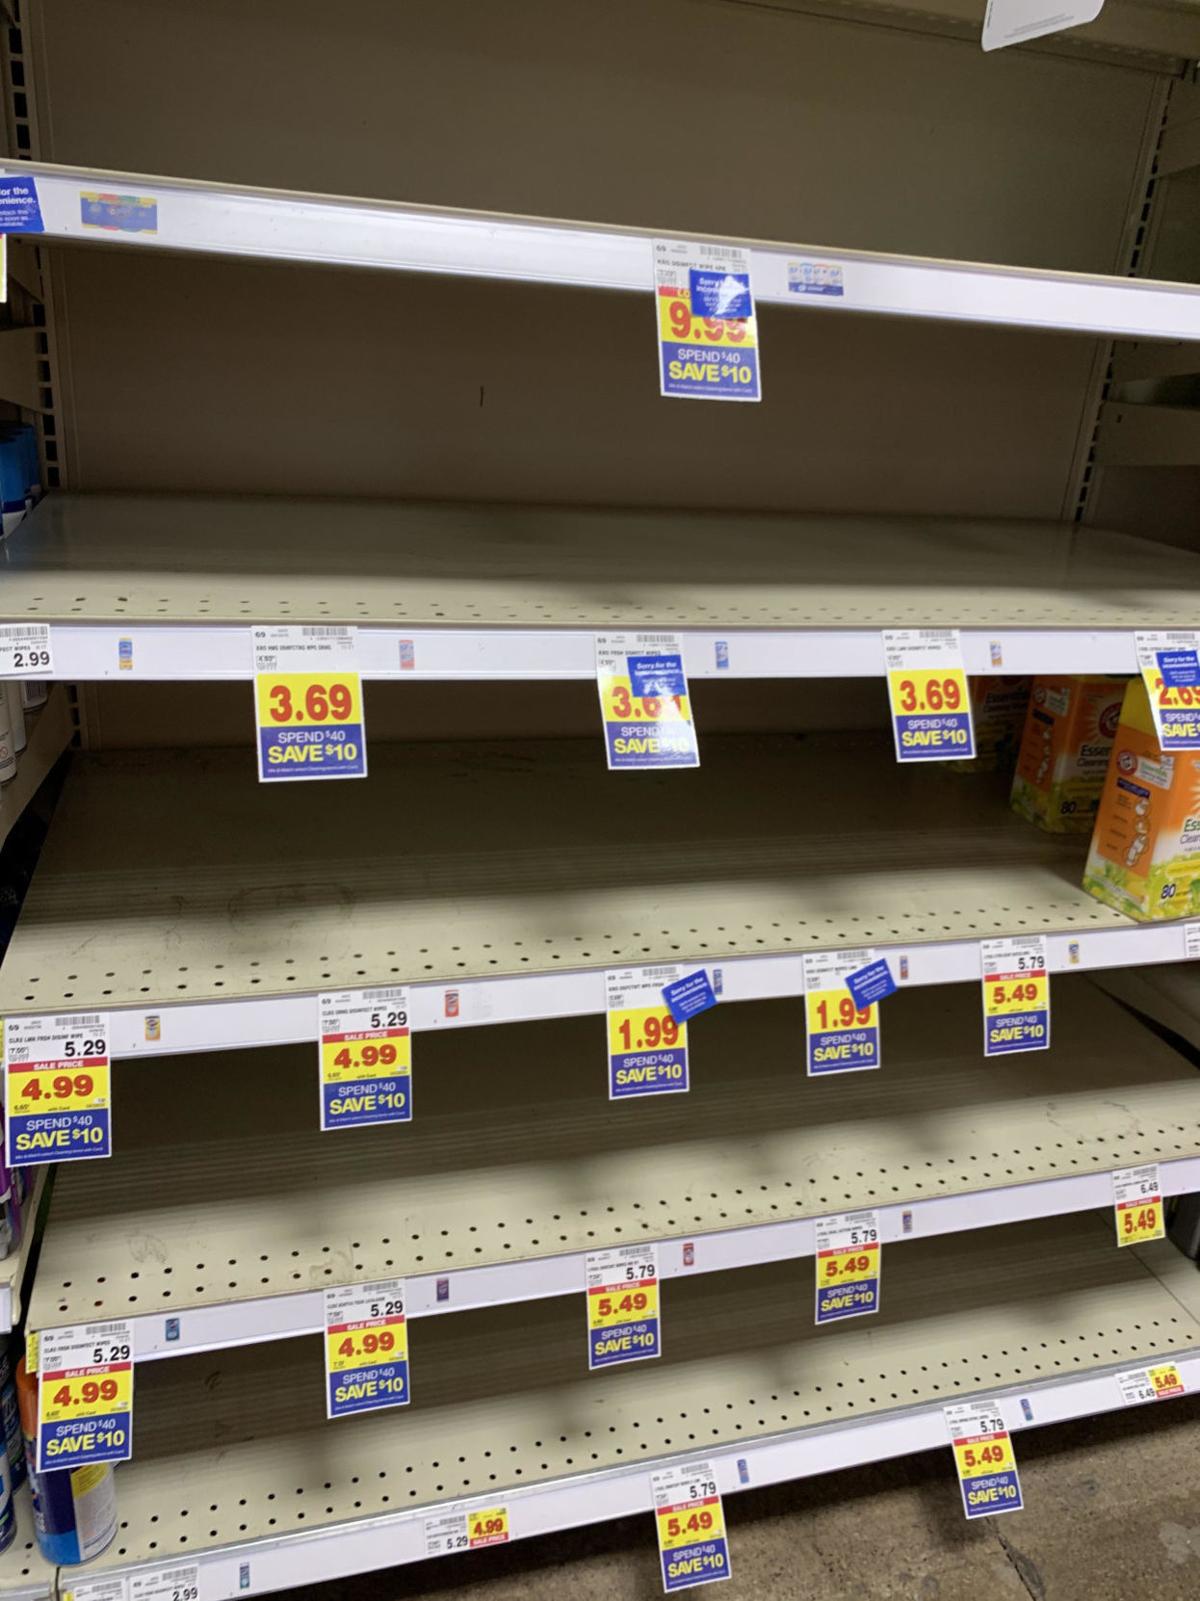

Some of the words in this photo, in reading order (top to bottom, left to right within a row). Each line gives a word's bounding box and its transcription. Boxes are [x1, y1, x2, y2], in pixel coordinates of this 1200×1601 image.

[13, 187, 29, 195] the
[669, 299, 746, 343] 9.99
[678, 349, 720, 362] SPEND
[722, 351, 740, 364] $40
[669, 361, 720, 382] SAVE
[721, 366, 752, 384] $10
[14, 651, 50, 667] 2.99
[270, 684, 352, 722] 3.69
[612, 686, 681, 718] 3.6
[900, 678, 960, 711] 3.69
[620, 726, 660, 737] SPEND
[907, 719, 941, 730] SPEND
[942, 718, 957, 728] $40
[1162, 722, 1195, 738] SAVE
[278, 731, 324, 743] SPEND
[326, 730, 345, 741] $40
[902, 730, 942, 747] SAVE
[943, 729, 967, 744] $10
[268, 745, 323, 763] SAVE
[325, 743, 357, 761] $10
[614, 738, 661, 754] SAVE
[1161, 883, 1176, 899] 80
[1018, 956, 1045, 970] 5.79
[993, 983, 1038, 1004] 5.49
[371, 1011, 407, 1028] 5.29
[816, 998, 871, 1029] 1.99
[996, 1017, 1024, 1028] SPEND
[365, 1031, 388, 1039] PRICE
[618, 1015, 678, 1050] 1.99
[820, 1035, 852, 1046] SPEND
[852, 1033, 866, 1042] $40
[990, 1028, 1023, 1042] SAVE
[1024, 1024, 1044, 1038] $10
[64, 1039, 106, 1057] 5.29
[334, 1044, 397, 1069] 4.99
[814, 1045, 852, 1062] SAVE
[852, 1042, 874, 1057] $10
[58, 1060, 84, 1068] PRICE
[624, 1056, 658, 1068] SPEND
[658, 1054, 674, 1063] $40
[616, 1067, 657, 1085] SAVE
[658, 1064, 682, 1079] $10
[21, 1074, 94, 1100] 4.99
[338, 1084, 377, 1097] SPEND
[379, 1081, 396, 1092] $40
[330, 1096, 376, 1115] SAVE
[378, 1093, 405, 1109] $10
[26, 1117, 70, 1131] SPEND
[73, 1115, 92, 1126] $40
[16, 1132, 70, 1151] SAVE
[72, 1127, 103, 1144] $10
[1124, 1208, 1156, 1234] 5.49
[851, 1229, 877, 1244] 5.79
[626, 1264, 655, 1280] 5.79
[826, 1256, 869, 1277] 5.49
[827, 1286, 855, 1298] SPEND
[370, 1300, 403, 1317] 5.29
[598, 1293, 647, 1316] 5.49
[821, 1295, 853, 1311] SAVE
[854, 1291, 874, 1304] $10
[602, 1327, 633, 1339] SPEND
[633, 1324, 647, 1333] $40
[338, 1331, 395, 1357] 4.99
[595, 1337, 632, 1355] SAVE
[633, 1333, 654, 1347] $10
[93, 1345, 130, 1363] 5.29
[64, 1369, 85, 1378] SALE
[87, 1366, 110, 1374] PRICE
[343, 1371, 378, 1384] SPEND
[379, 1367, 395, 1377] $40
[1154, 1373, 1177, 1388] 5.49
[53, 1379, 118, 1407] 4.99
[335, 1381, 378, 1402] SAVE
[379, 1377, 403, 1392] $10
[56, 1422, 97, 1437] SPEND
[98, 1419, 116, 1430] $40
[980, 1418, 1004, 1432] 5.79
[46, 1434, 95, 1456] SAVE
[97, 1430, 125, 1447] $10
[964, 1445, 1004, 1467] 5.49
[690, 1481, 716, 1498] 5.79
[971, 1479, 996, 1490] SPEND
[968, 1488, 999, 1505] SAVE
[998, 1485, 1016, 1498] $10
[474, 1518, 503, 1535] 4.99
[667, 1511, 713, 1536] 5.49
[447, 1536, 468, 1549] 5.29
[673, 1549, 702, 1562] SPEND
[668, 1558, 703, 1578] SAVE
[703, 1553, 724, 1568] $10
[172, 1587, 198, 1601] 2.99
